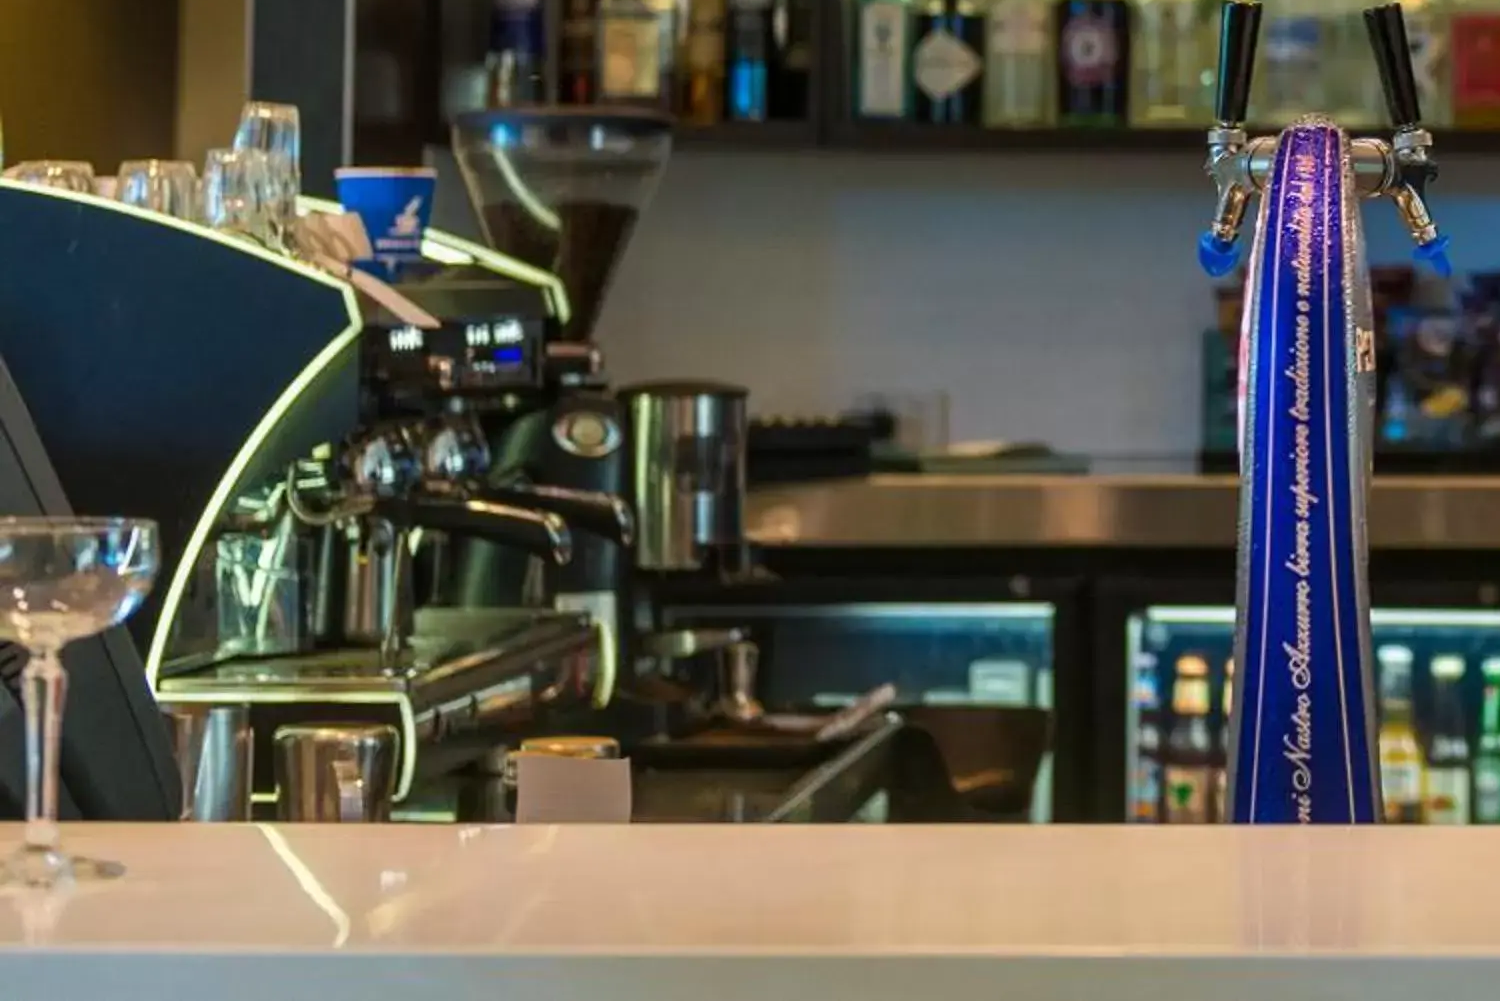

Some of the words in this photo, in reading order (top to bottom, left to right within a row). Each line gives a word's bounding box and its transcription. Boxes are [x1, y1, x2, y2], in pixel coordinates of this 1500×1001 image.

[1296, 299, 1310, 312] e
[1284, 314, 1310, 421] tradizione
[1288, 424, 1319, 518] superiore
[1284, 520, 1311, 577] birra
[1282, 580, 1311, 689] Azzurro
[1283, 692, 1311, 791] Nastro
[1291, 792, 1311, 824] ni
